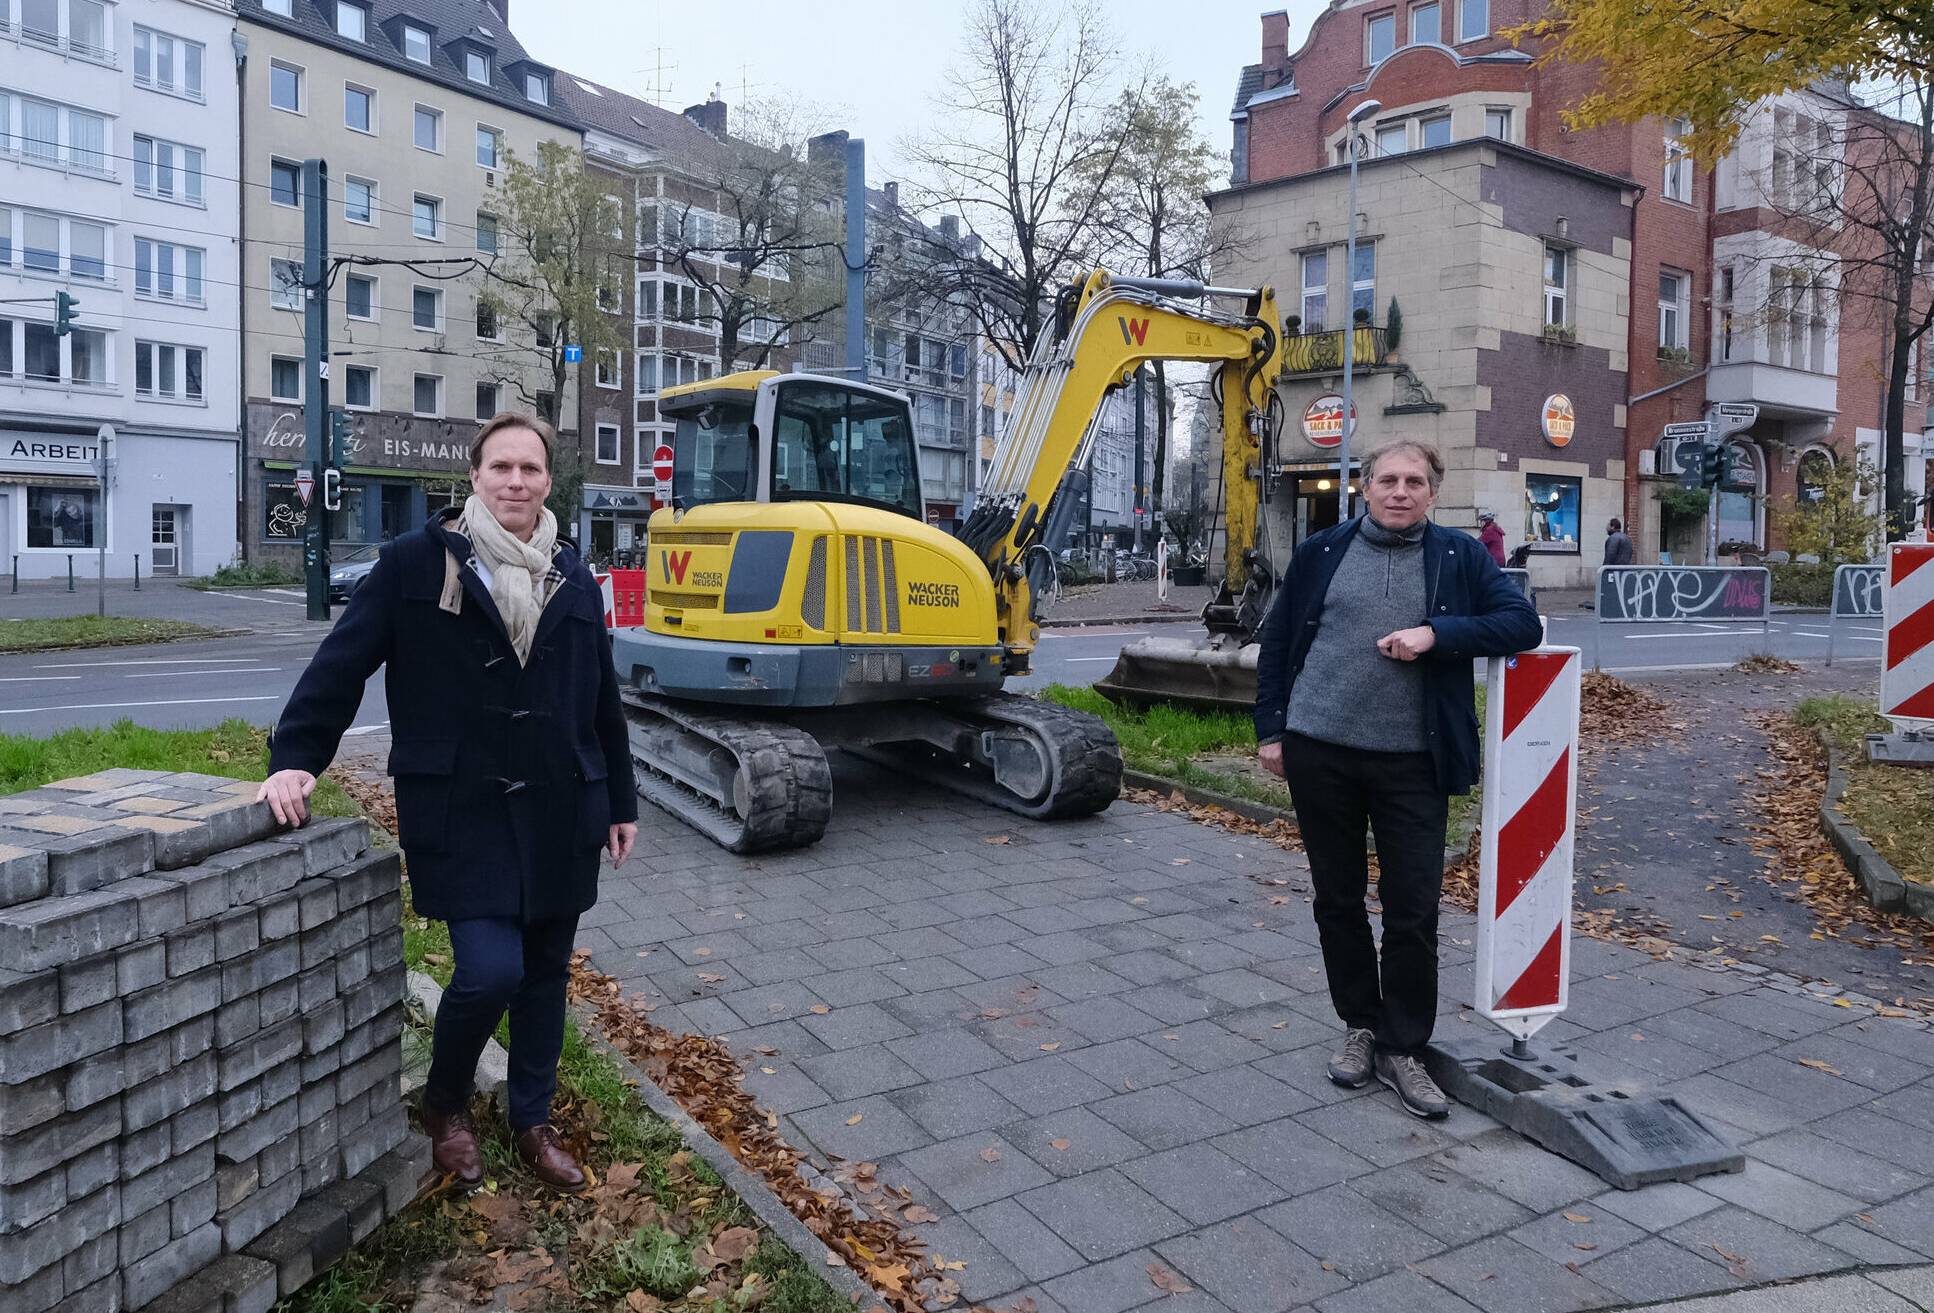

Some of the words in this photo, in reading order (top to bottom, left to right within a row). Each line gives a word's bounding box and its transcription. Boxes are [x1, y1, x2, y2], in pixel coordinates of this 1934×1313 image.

[567, 347, 580, 361] T
[692, 571, 723, 580] WACKER
[692, 579, 723, 588] NEUSON
[908, 582, 960, 597] WACKER
[908, 594, 960, 608] NEUSON
